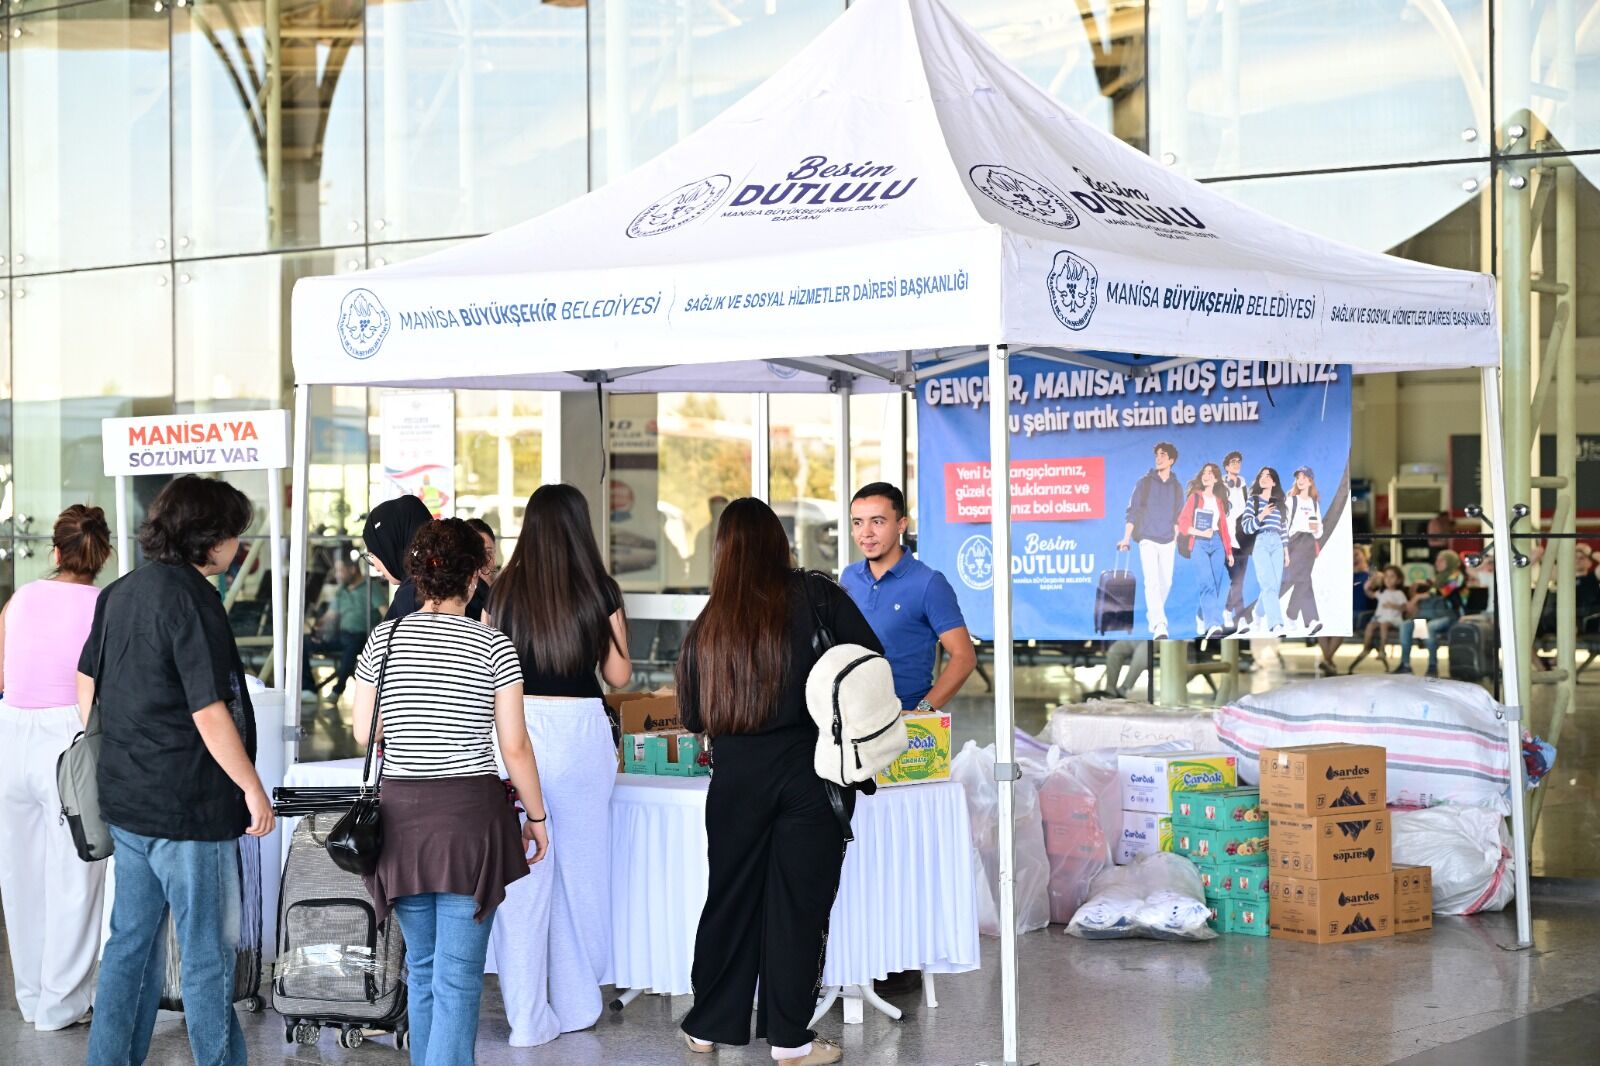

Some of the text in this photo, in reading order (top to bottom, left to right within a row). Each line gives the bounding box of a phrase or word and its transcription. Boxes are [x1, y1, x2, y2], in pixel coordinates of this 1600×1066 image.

[787, 155, 896, 181] Besim
[729, 177, 918, 206] DUTLULU
[684, 269, 969, 312] SAĞLIK VE SOSYAL HİZMETLER DAİRESİ BAŞKANLIĞI
[1106, 280, 1159, 308] MANİSA
[1163, 284, 1245, 316] BÜYÜKŞEHİR
[1246, 294, 1316, 320] BELEDİYESİ
[400, 291, 662, 330] MANİSA BÜYÜKŞEHİR BELEDİYESİ
[1331, 304, 1356, 322] SAĞLIK
[1357, 308, 1366, 324] VE
[1367, 308, 1391, 325] SOSYAL
[1392, 306, 1427, 326] HİZMETLER
[1428, 308, 1453, 326] DAİRESİ
[925, 374, 1028, 410] GENÇLR,
[1167, 361, 1216, 396] HOŞ
[1023, 406, 1070, 438] şehir
[1073, 404, 1119, 430] artık
[1122, 400, 1168, 427] sizin
[1171, 399, 1196, 425] de
[1199, 395, 1259, 423] eviniz
[129, 420, 258, 447] MANİSA'YA
[129, 447, 259, 468] SÖZÜMÜZ VAR
[956, 464, 1086, 480] Yeni bangıçlarınız,
[955, 485, 985, 501] güzel
[1074, 484, 1090, 495] ve
[1033, 501, 1053, 514] bol
[1055, 500, 1092, 513] olsun.
[1024, 533, 1078, 554] Besim
[1011, 554, 1095, 575] DUTLULU
[652, 715, 677, 727] sard
[908, 736, 936, 749] rdak
[1333, 765, 1370, 777] sardes
[1333, 850, 1369, 863] sardes
[1346, 891, 1380, 903] sardes
